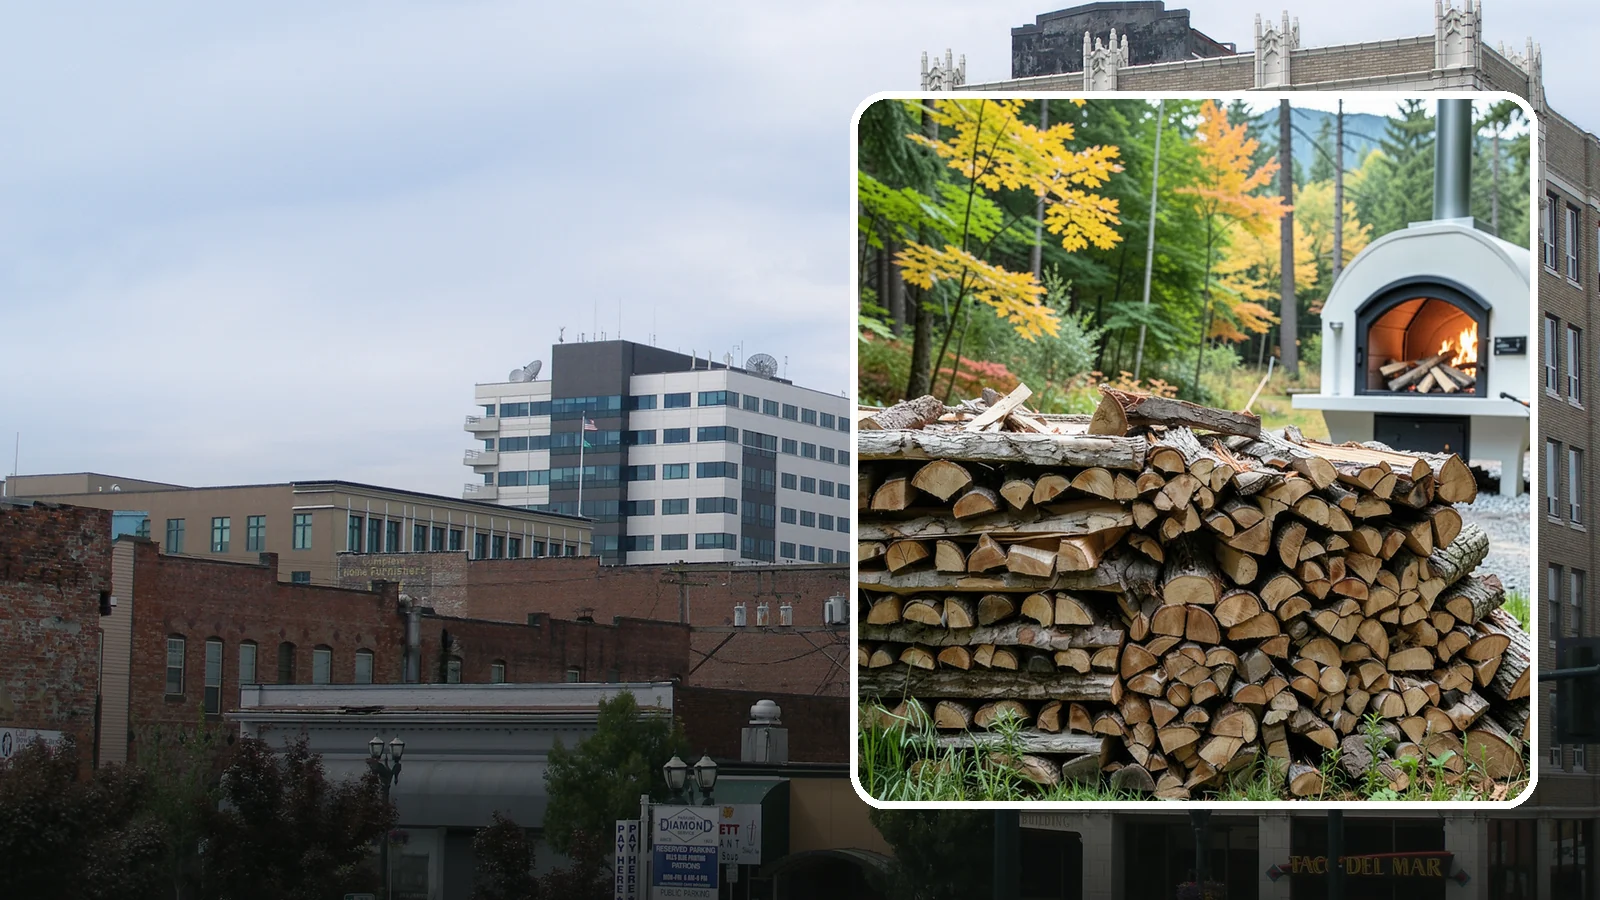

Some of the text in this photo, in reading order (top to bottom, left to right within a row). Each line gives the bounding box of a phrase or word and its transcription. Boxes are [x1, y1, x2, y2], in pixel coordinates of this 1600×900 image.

[660, 818, 713, 832] DIAMOND
[1022, 815, 1070, 828] BUILDING
[656, 845, 688, 853] RESERVED
[616, 825, 625, 893] PAY HERE
[627, 824, 637, 893] PAY HERE
[671, 862, 701, 870] PATRONS
[1344, 856, 1385, 876] DEL
[1391, 857, 1442, 877] MAR
[660, 888, 710, 898] PUBLIC PARKING
